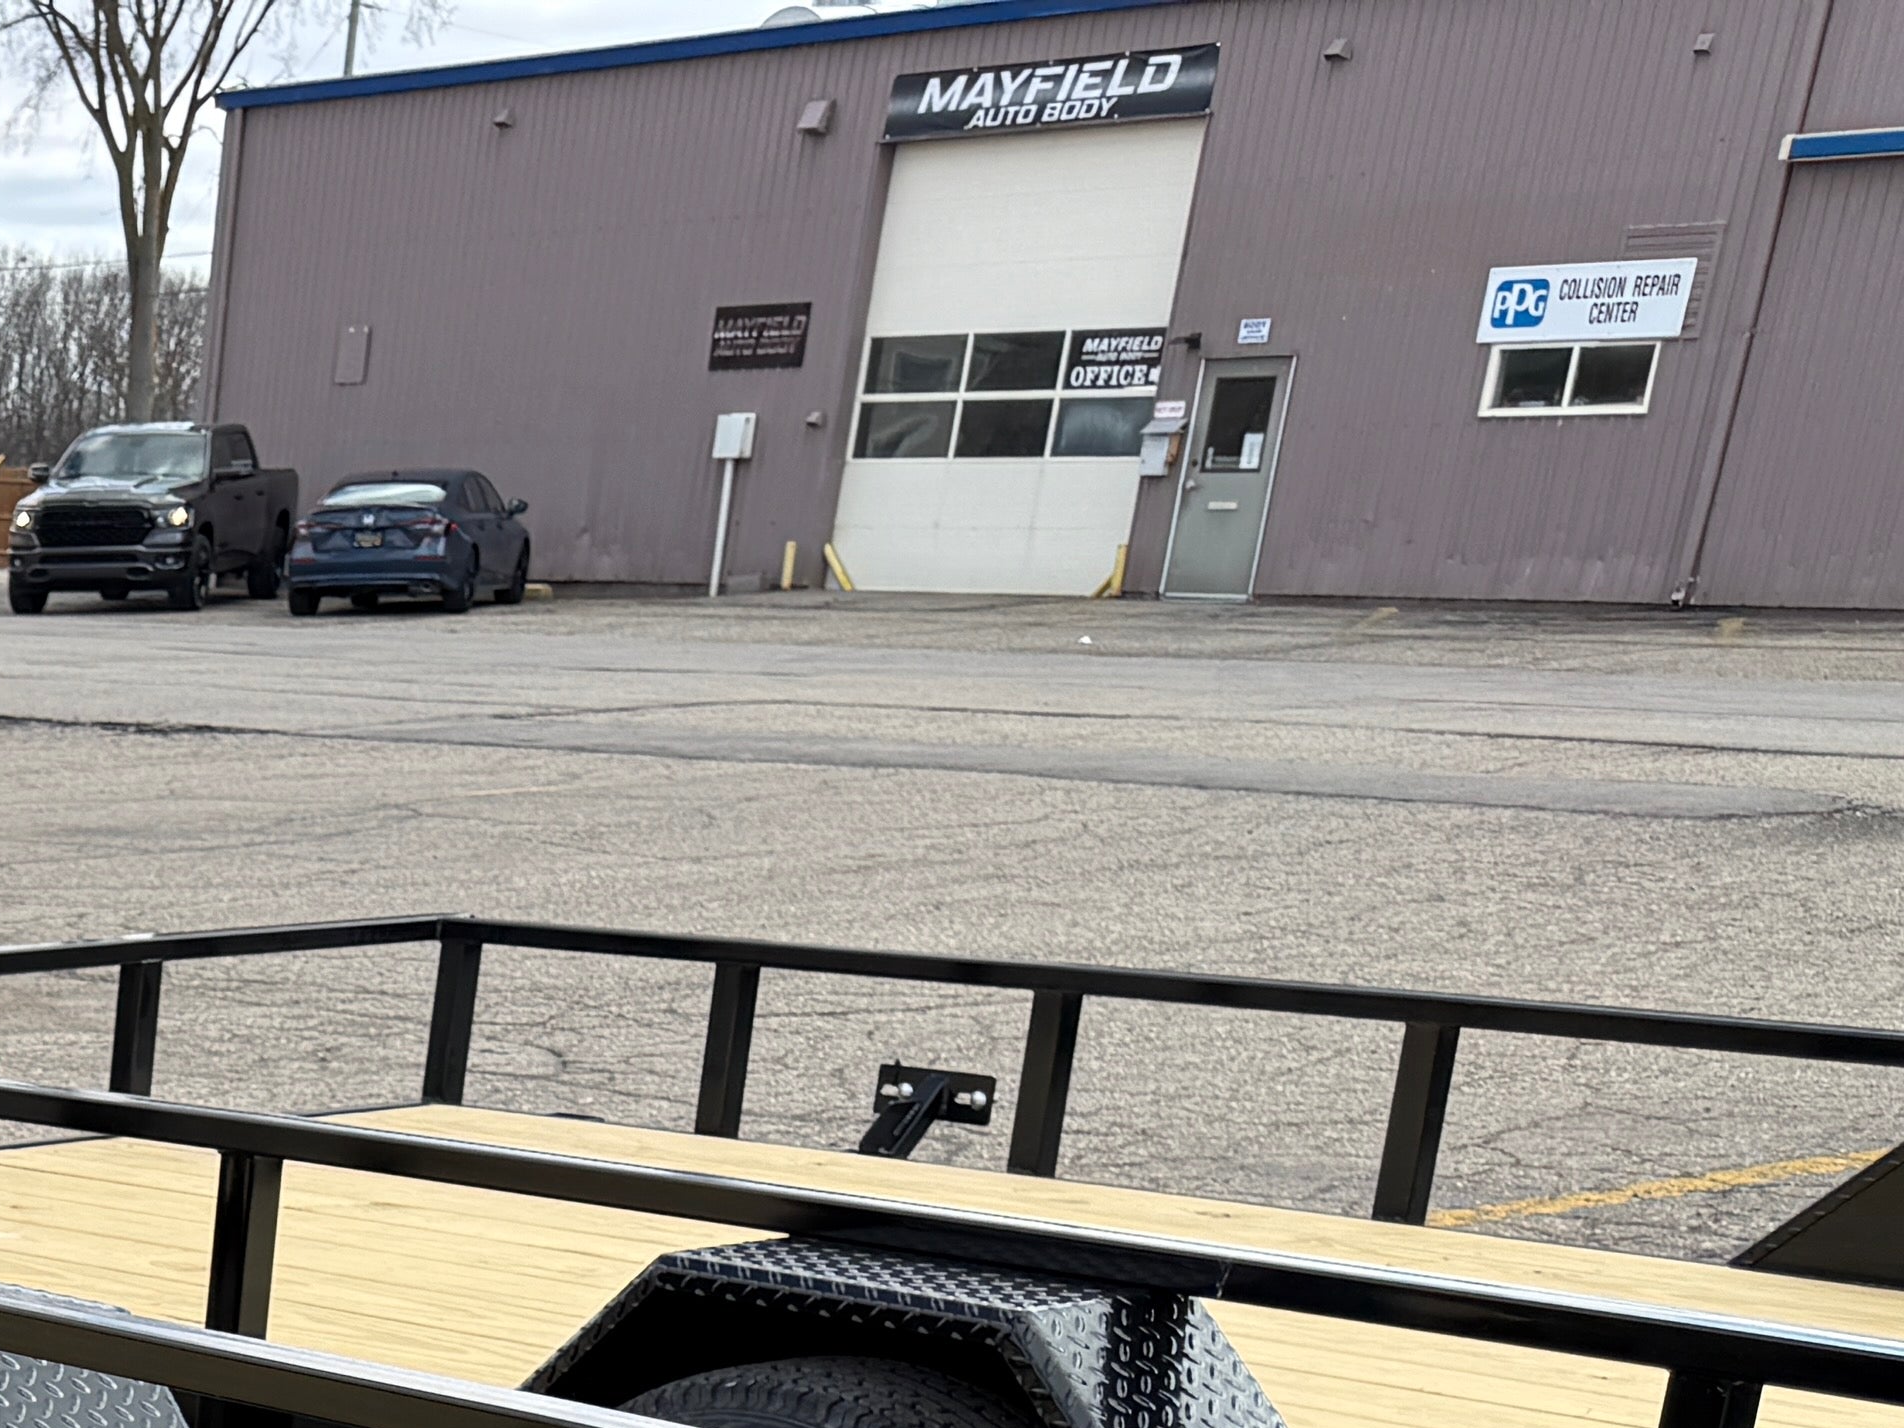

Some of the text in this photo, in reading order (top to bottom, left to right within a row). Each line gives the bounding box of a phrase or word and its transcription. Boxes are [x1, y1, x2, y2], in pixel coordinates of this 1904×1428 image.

[917, 54, 1182, 114] MAYFIELD
[967, 97, 1118, 129] AUTO BODY
[1558, 276, 1627, 301] COLLISION
[1632, 273, 1682, 298] REPAIR
[1588, 301, 1639, 325] CENTER
[1082, 336, 1163, 352] MAYFIELD
[1070, 365, 1148, 387] OFFICE
